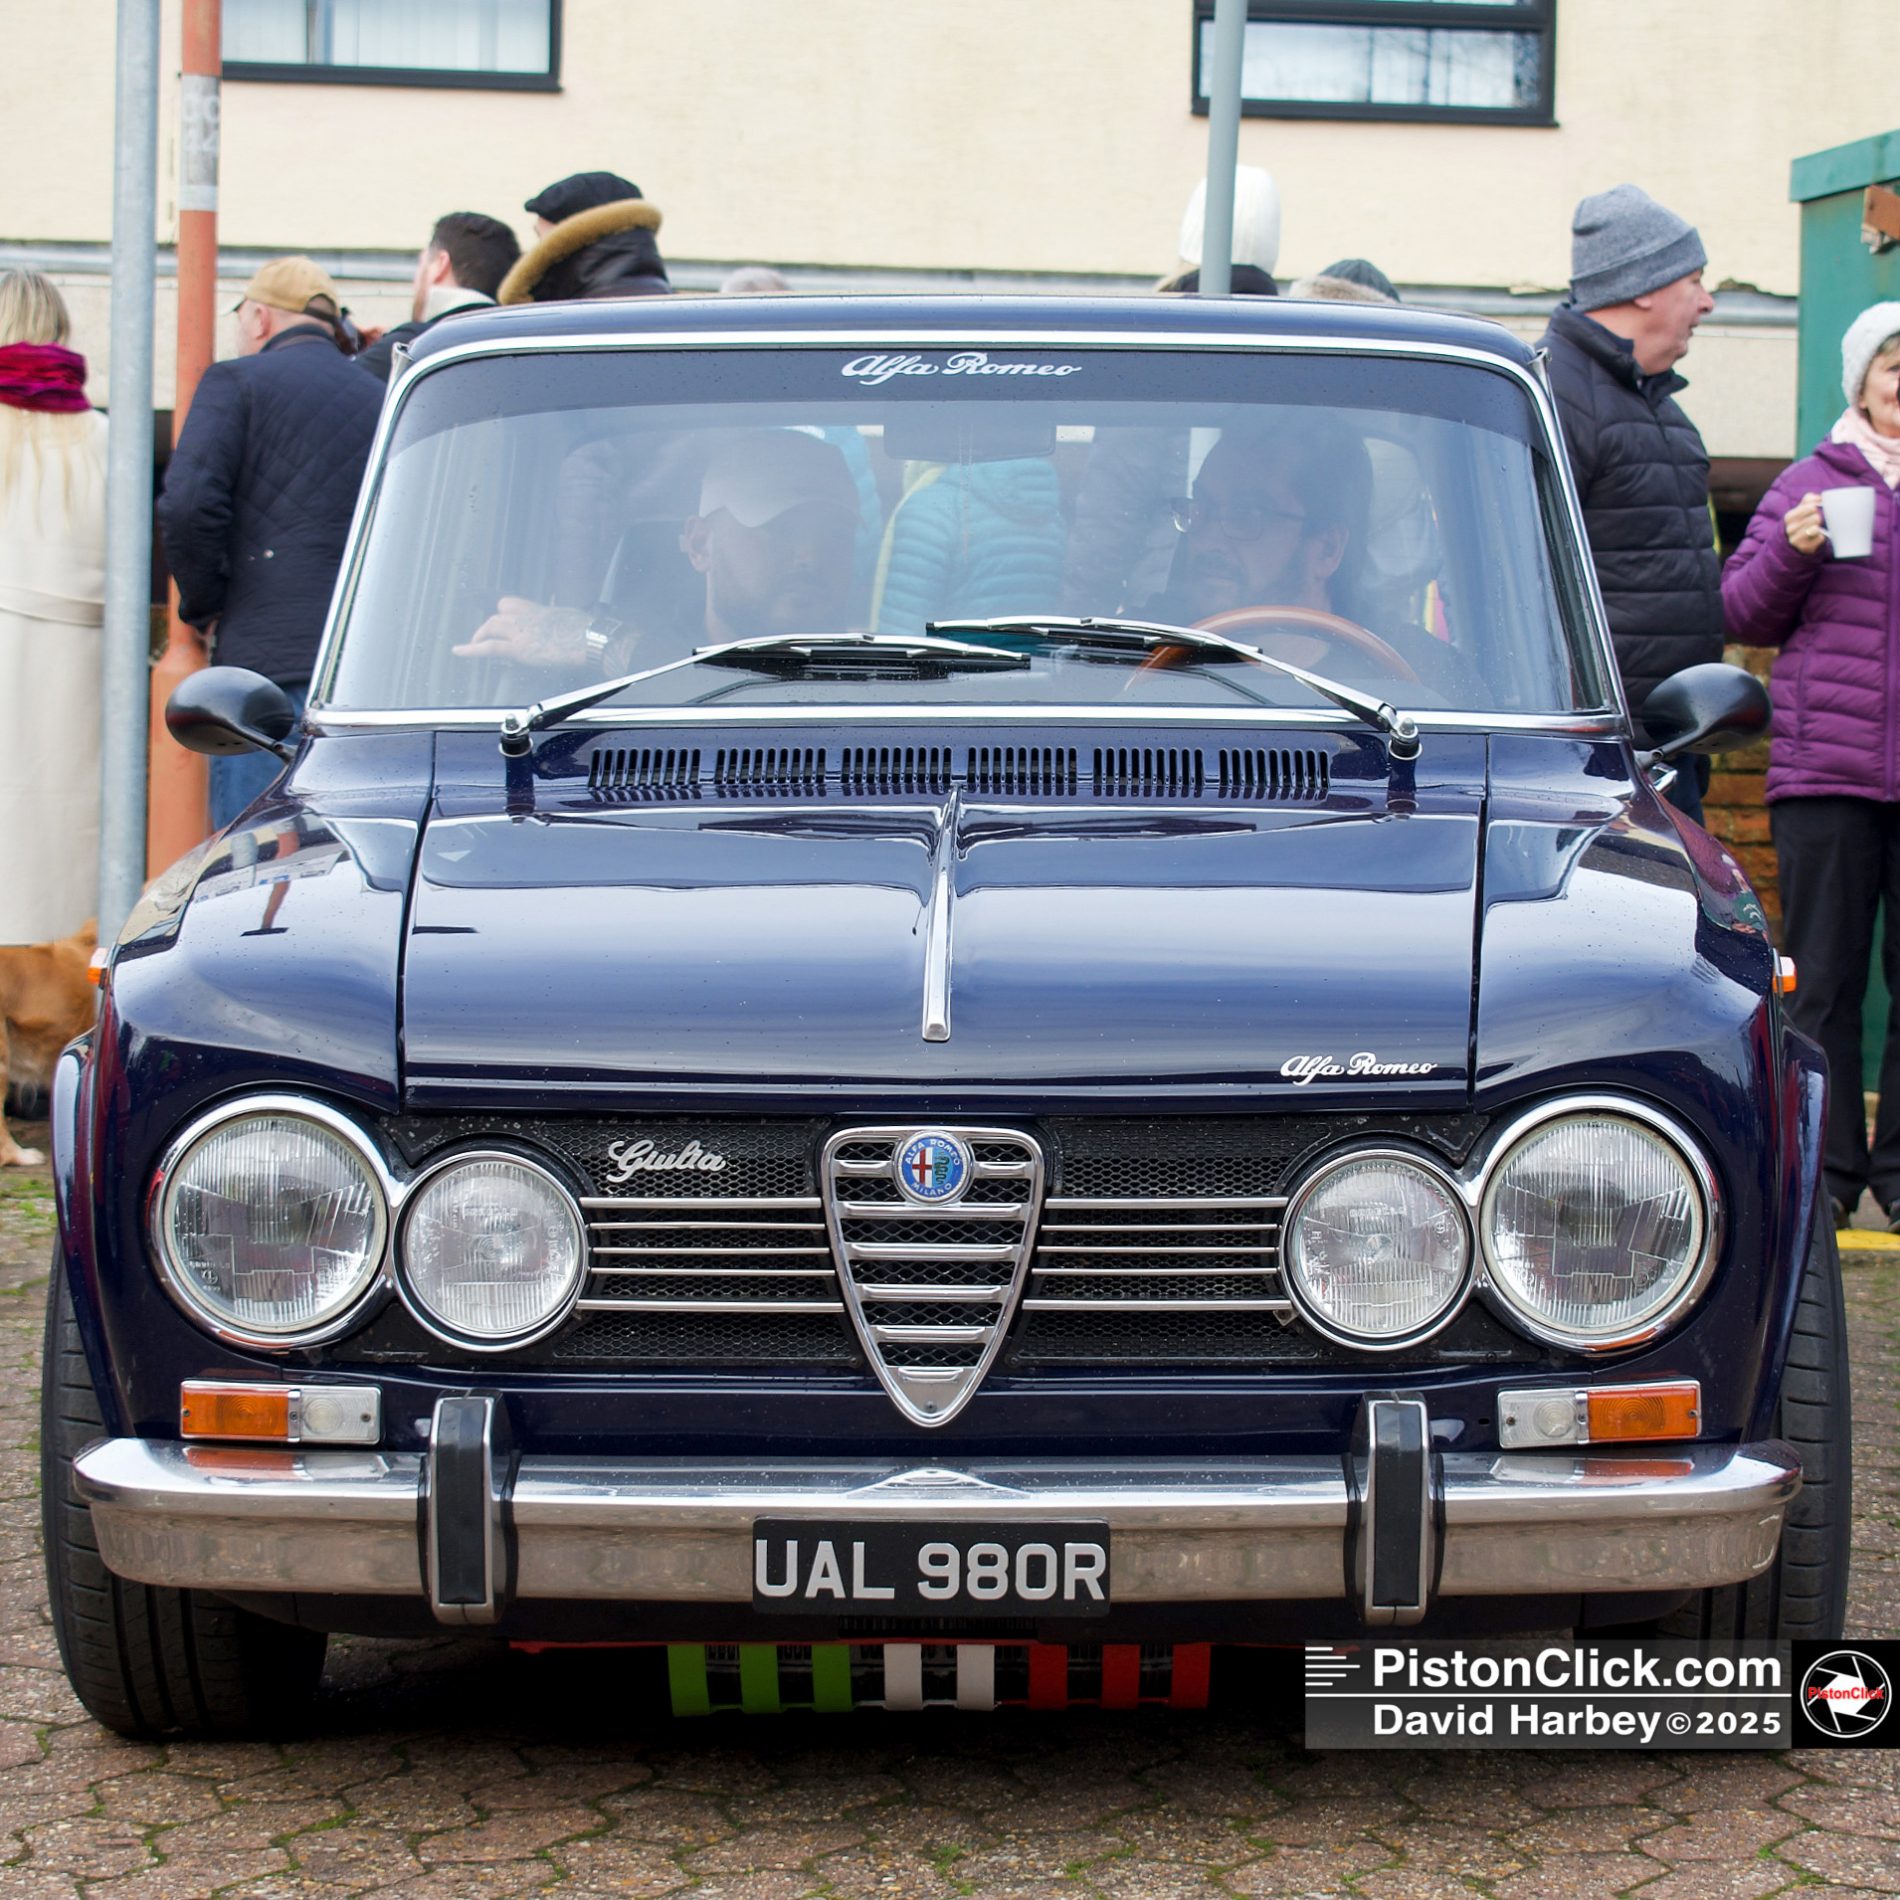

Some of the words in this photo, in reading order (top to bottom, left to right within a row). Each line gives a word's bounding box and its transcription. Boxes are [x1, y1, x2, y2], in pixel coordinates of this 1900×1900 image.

[841, 354, 939, 386] Alfa
[941, 351, 1083, 377] Romeo
[1280, 1055, 1345, 1087] Alfa
[1346, 1051, 1438, 1076] Romeo
[606, 1139, 727, 1182] Giulia
[905, 1142, 925, 1165] ALFA
[911, 1182, 952, 1196] MILANO
[755, 1539, 896, 1600] UAL
[917, 1541, 1106, 1601] 980R
